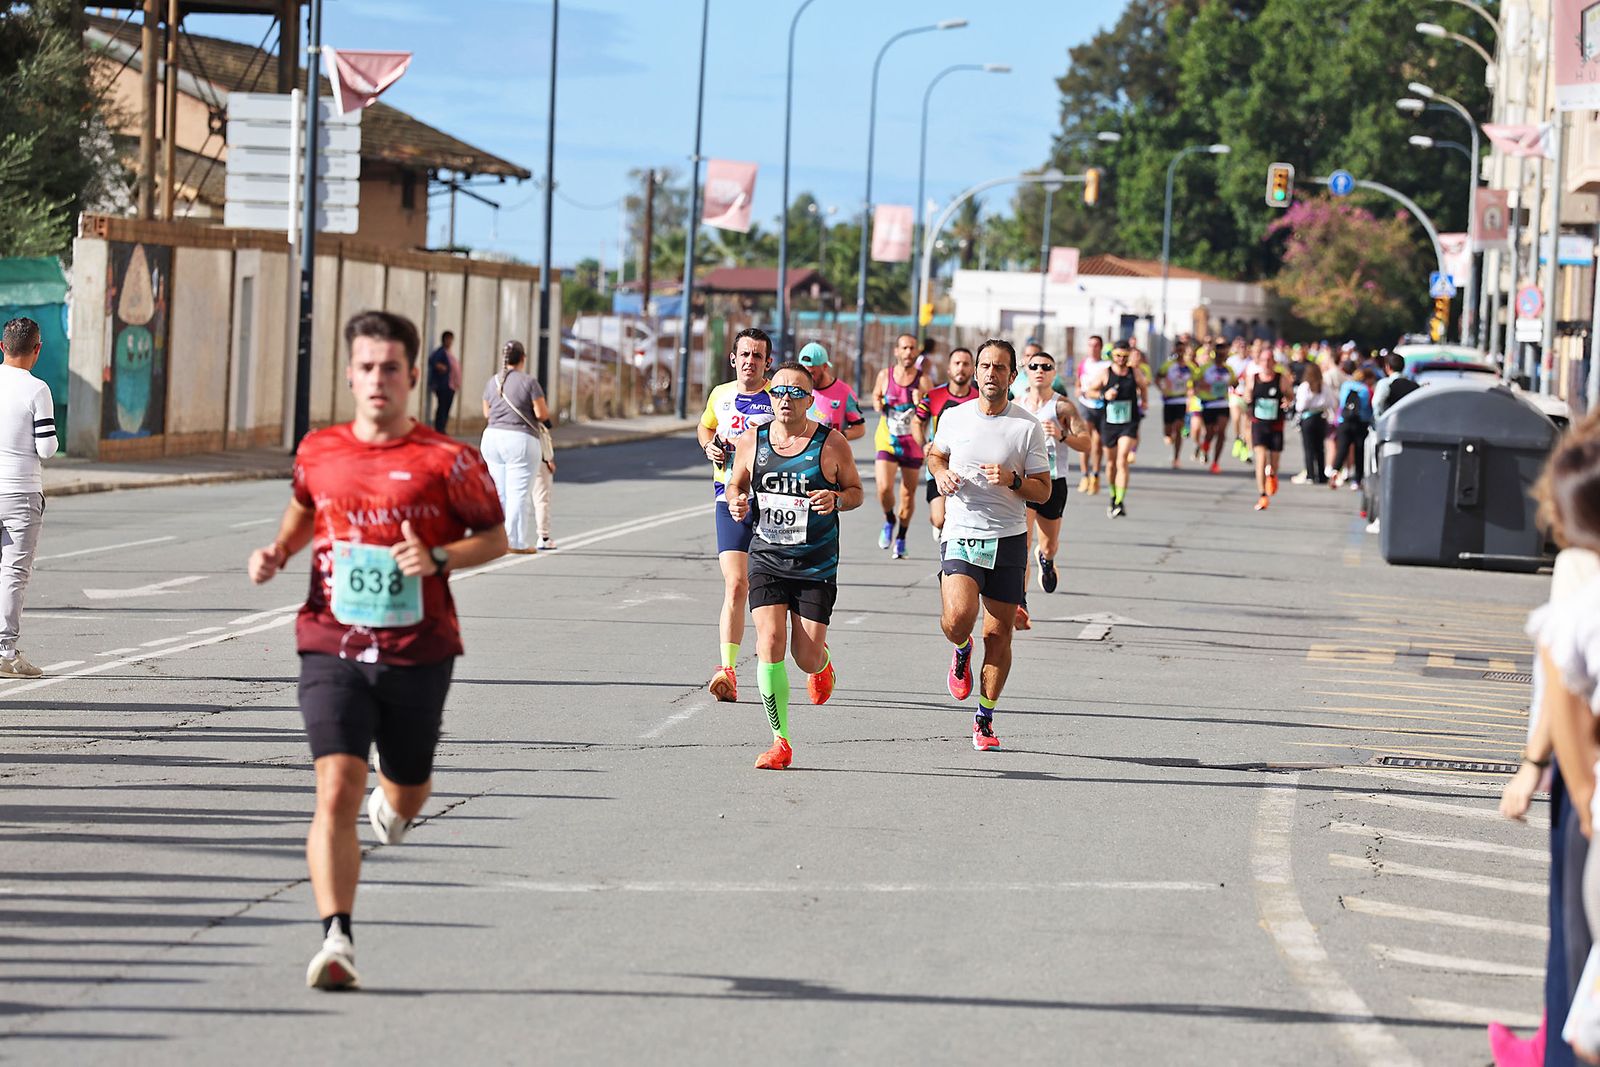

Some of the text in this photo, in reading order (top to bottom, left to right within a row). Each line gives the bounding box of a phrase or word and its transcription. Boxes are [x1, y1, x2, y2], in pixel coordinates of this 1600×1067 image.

[761, 472, 809, 495] Giit
[764, 508, 796, 526] 109
[350, 568, 403, 597] 638
